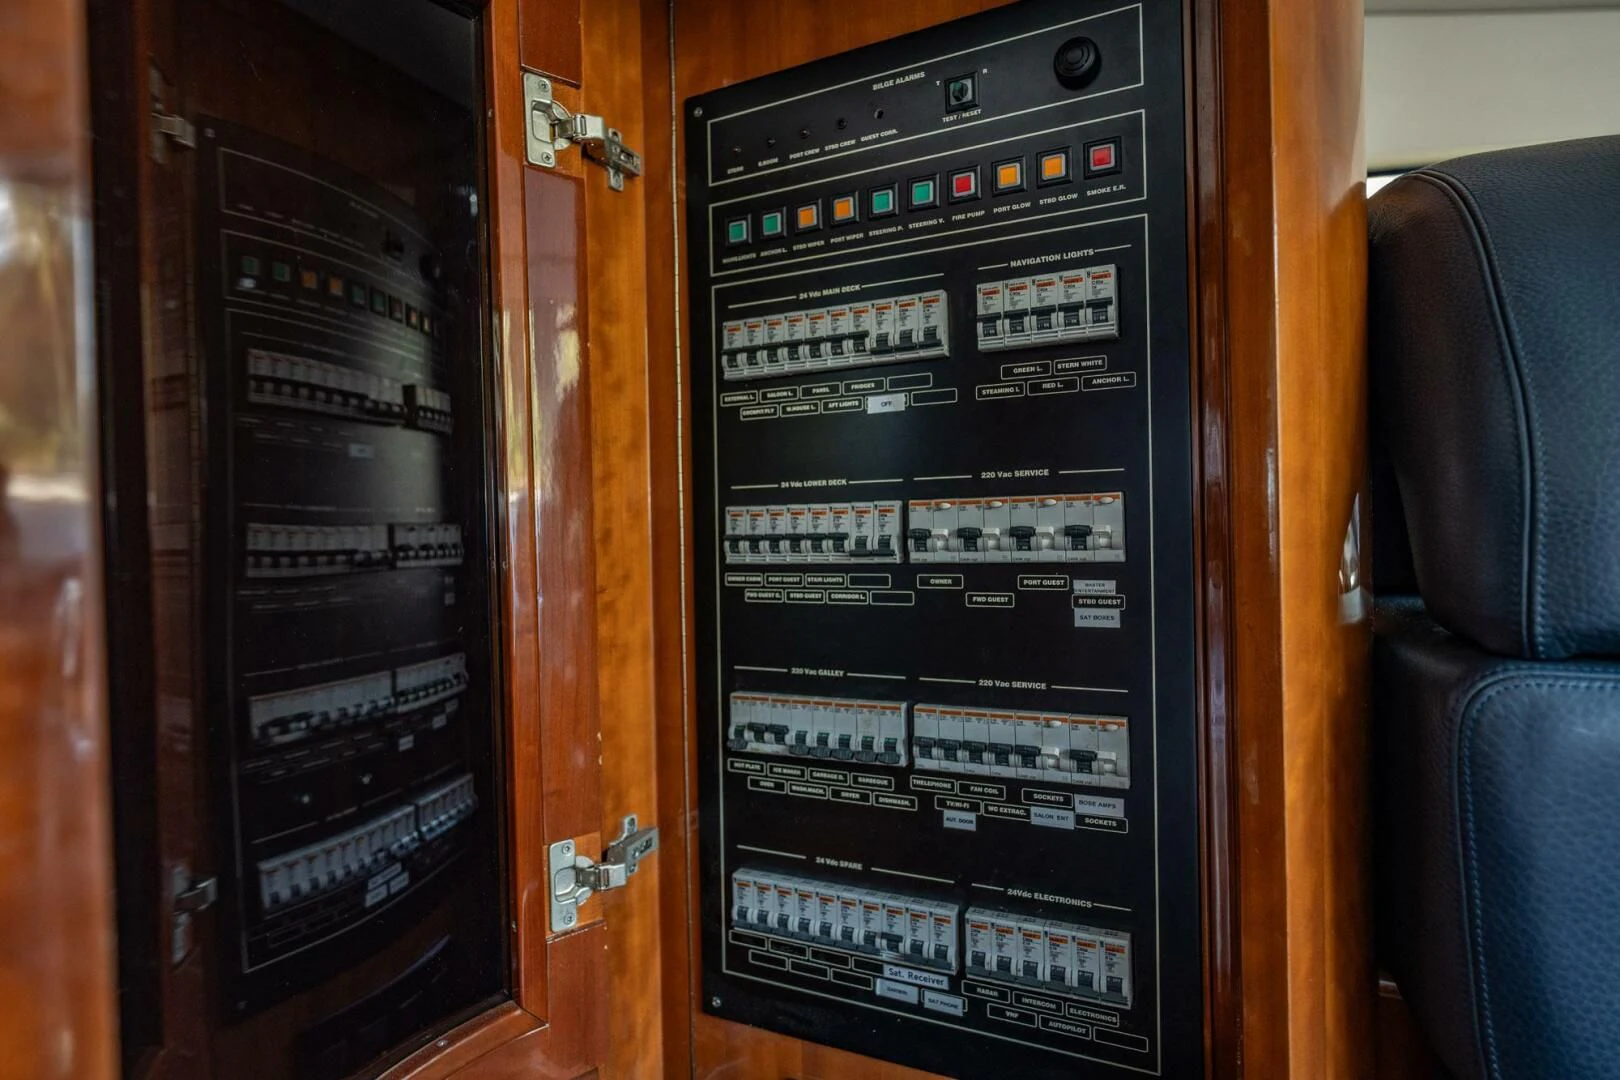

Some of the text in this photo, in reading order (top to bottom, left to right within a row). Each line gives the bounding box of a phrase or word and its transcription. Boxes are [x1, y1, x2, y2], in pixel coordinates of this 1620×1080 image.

[872, 72, 926, 91] BILGE ALARMS
[942, 114, 957, 123] TEST
[962, 108, 982, 118] RESET
[860, 133, 880, 142] GUEST
[840, 139, 856, 148] CREW
[789, 152, 804, 160] PORT
[1086, 187, 1112, 196] SMOKE
[1039, 193, 1078, 205] STBD GLOW
[993, 202, 1031, 214] PORT GLOW
[966, 210, 985, 219] PUMP
[908, 219, 938, 229] STEERING
[868, 226, 897, 237] STEERING
[830, 232, 864, 244] PORT WIPER
[1010, 249, 1094, 267] NAVIGATION LIGHTS
[822, 288, 841, 297] MAIN
[842, 284, 861, 293] DECK
[1057, 359, 1103, 369] STERN WHITE
[1013, 366, 1036, 374] GREEN
[1092, 376, 1122, 385] ANCHOR
[982, 387, 1015, 395] STEAMING
[1014, 469, 1049, 478] SERVICE
[804, 668, 817, 676] Vac
[818, 669, 844, 677] GALLEY
[978, 679, 1047, 690] 220 Vac SERVICE
[1033, 793, 1064, 802] SOCKETS
[999, 806, 1027, 816] EXTRAC.
[1085, 817, 1117, 827] SOCKETS
[839, 860, 862, 870] SPARE
[1007, 888, 1092, 908] 24Vdc ELECTRONICS
[889, 967, 944, 985] Sat. Receiver
[976, 987, 998, 997] RADAR
[1022, 997, 1056, 1009] INTERCOM
[1070, 1008, 1117, 1023] ELECTRONICS
[1048, 1021, 1087, 1034] AUTOPILOT
